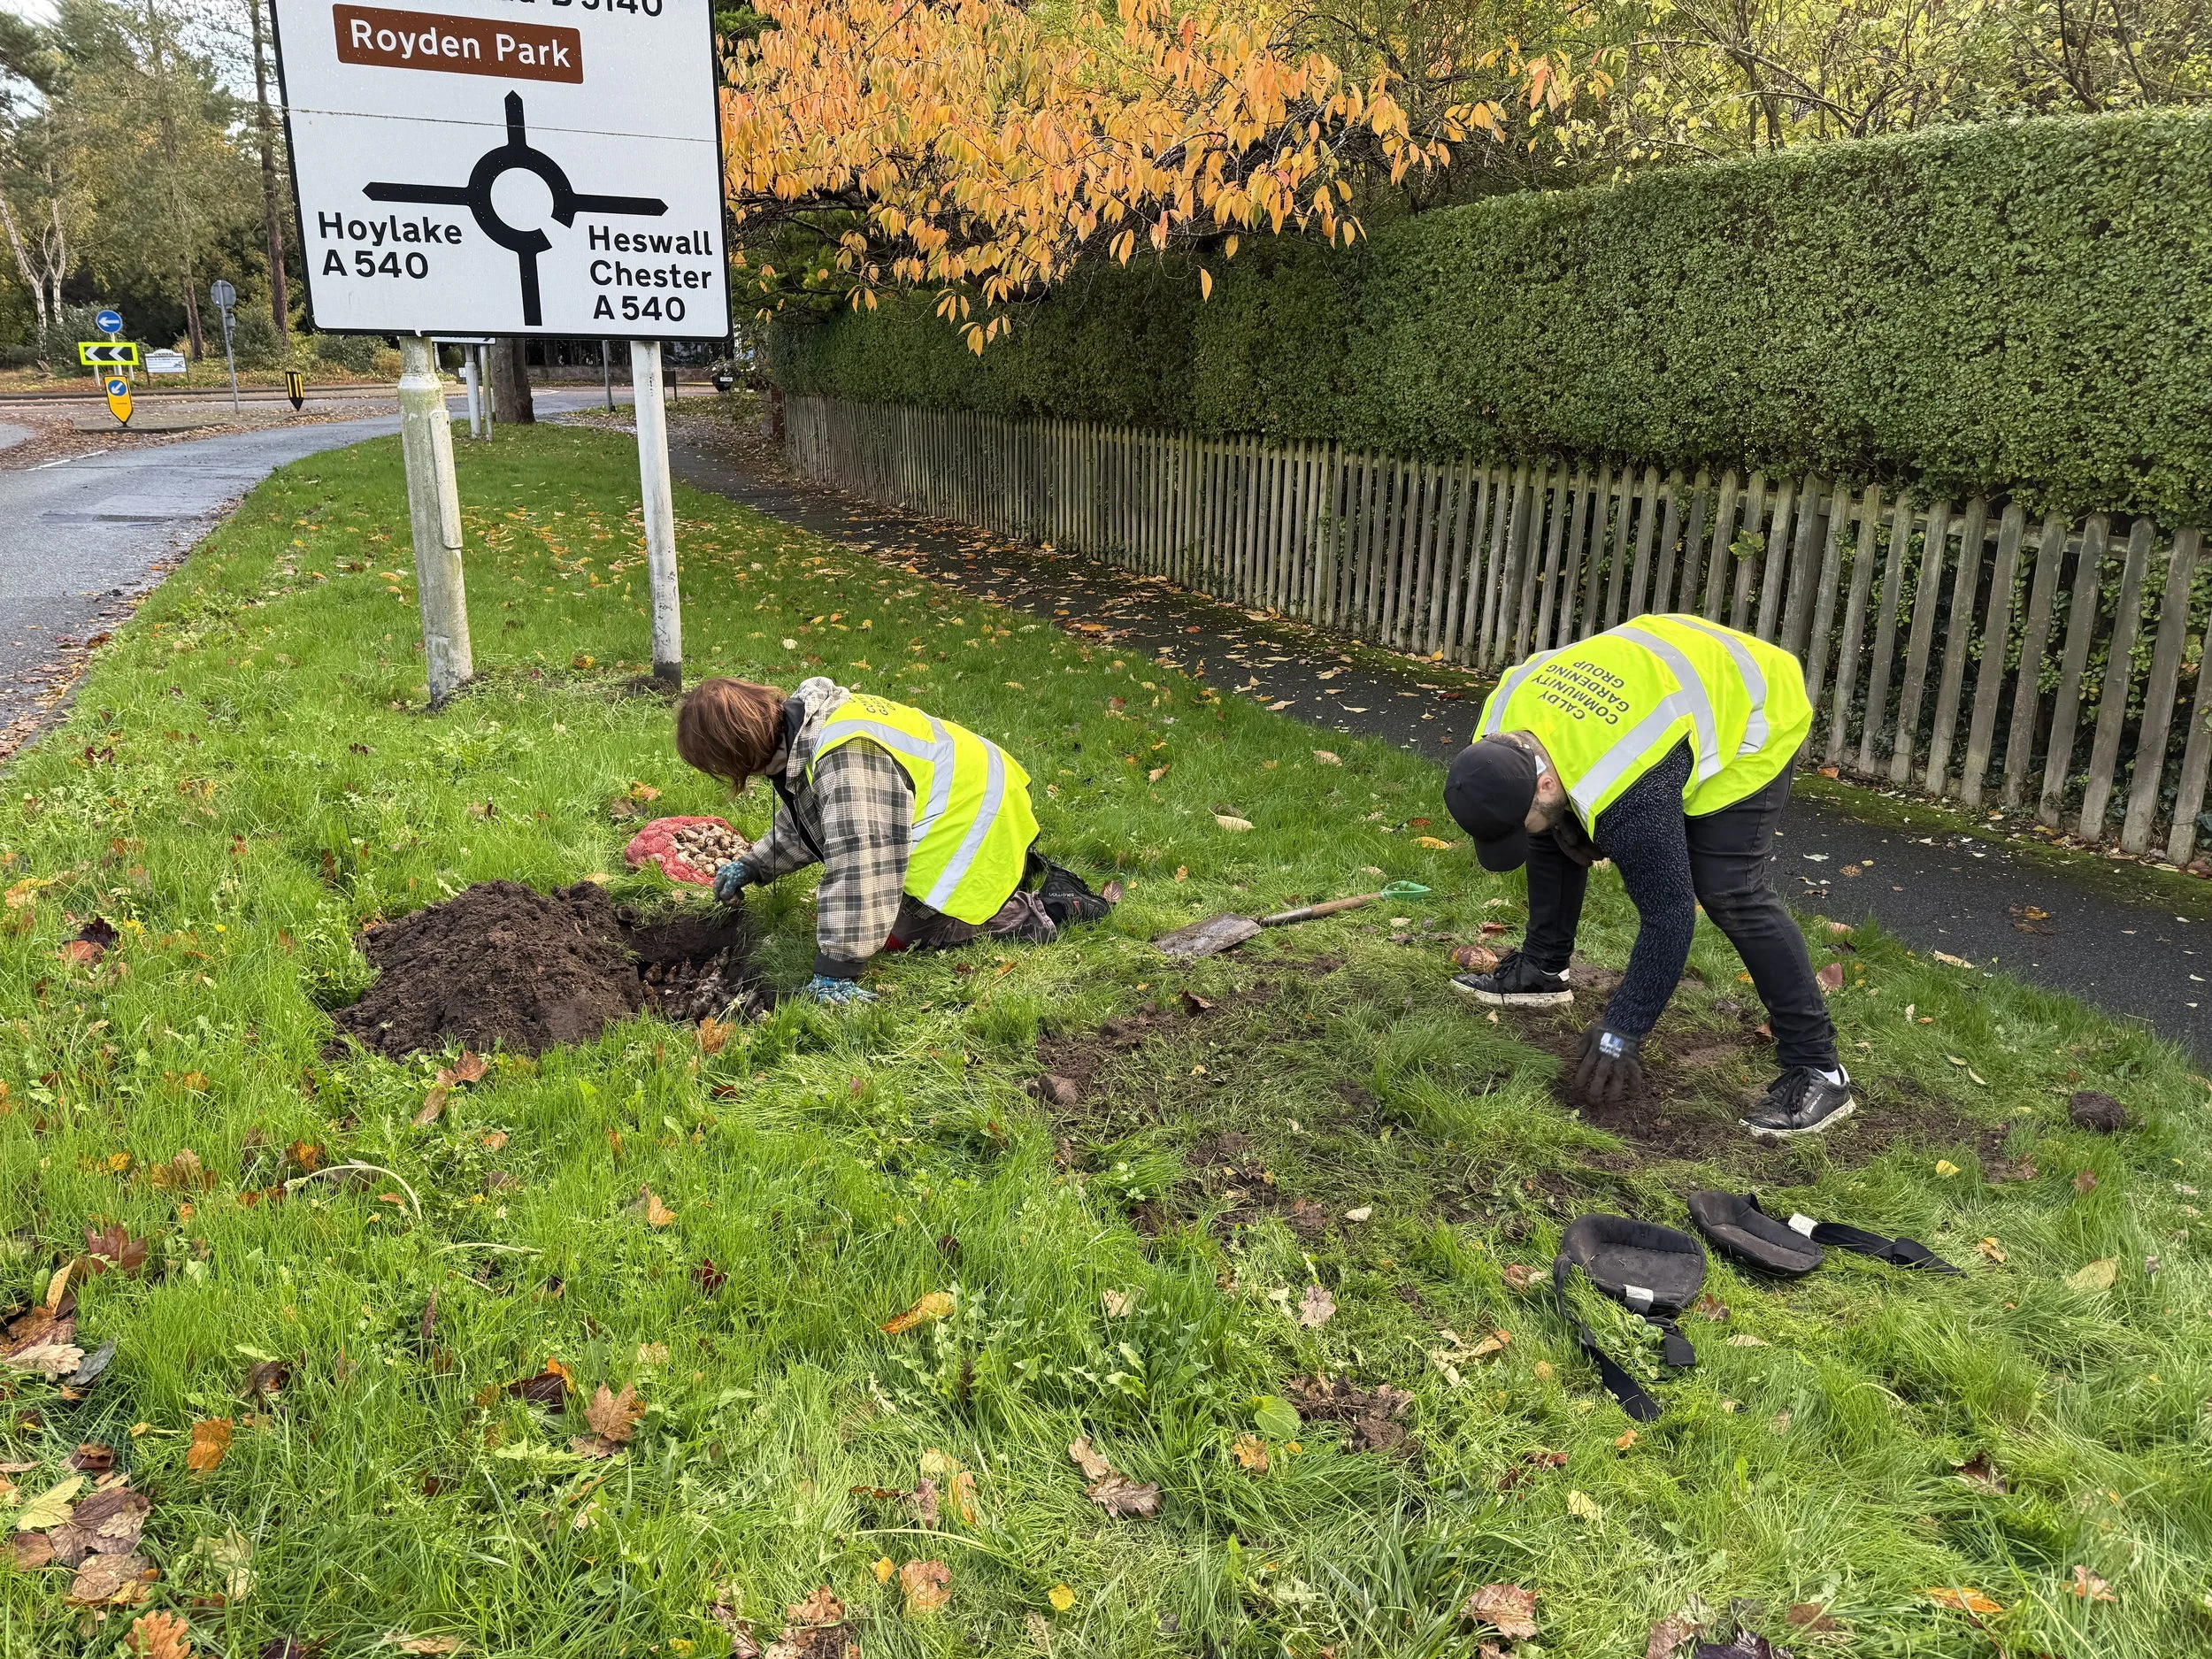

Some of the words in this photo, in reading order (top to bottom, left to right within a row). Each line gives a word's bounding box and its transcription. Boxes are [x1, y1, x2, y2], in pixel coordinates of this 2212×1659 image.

[349, 19, 481, 59] Royden
[495, 33, 572, 68] Park
[318, 211, 463, 247] Hoylake
[588, 225, 713, 256] Heswall
[589, 259, 712, 289] Chester
[1545, 664, 1630, 712] GARDENING
[1572, 661, 1624, 688] GROUP
[1531, 674, 1618, 725] COMMUNITY
[1537, 690, 1586, 720] CALDY
